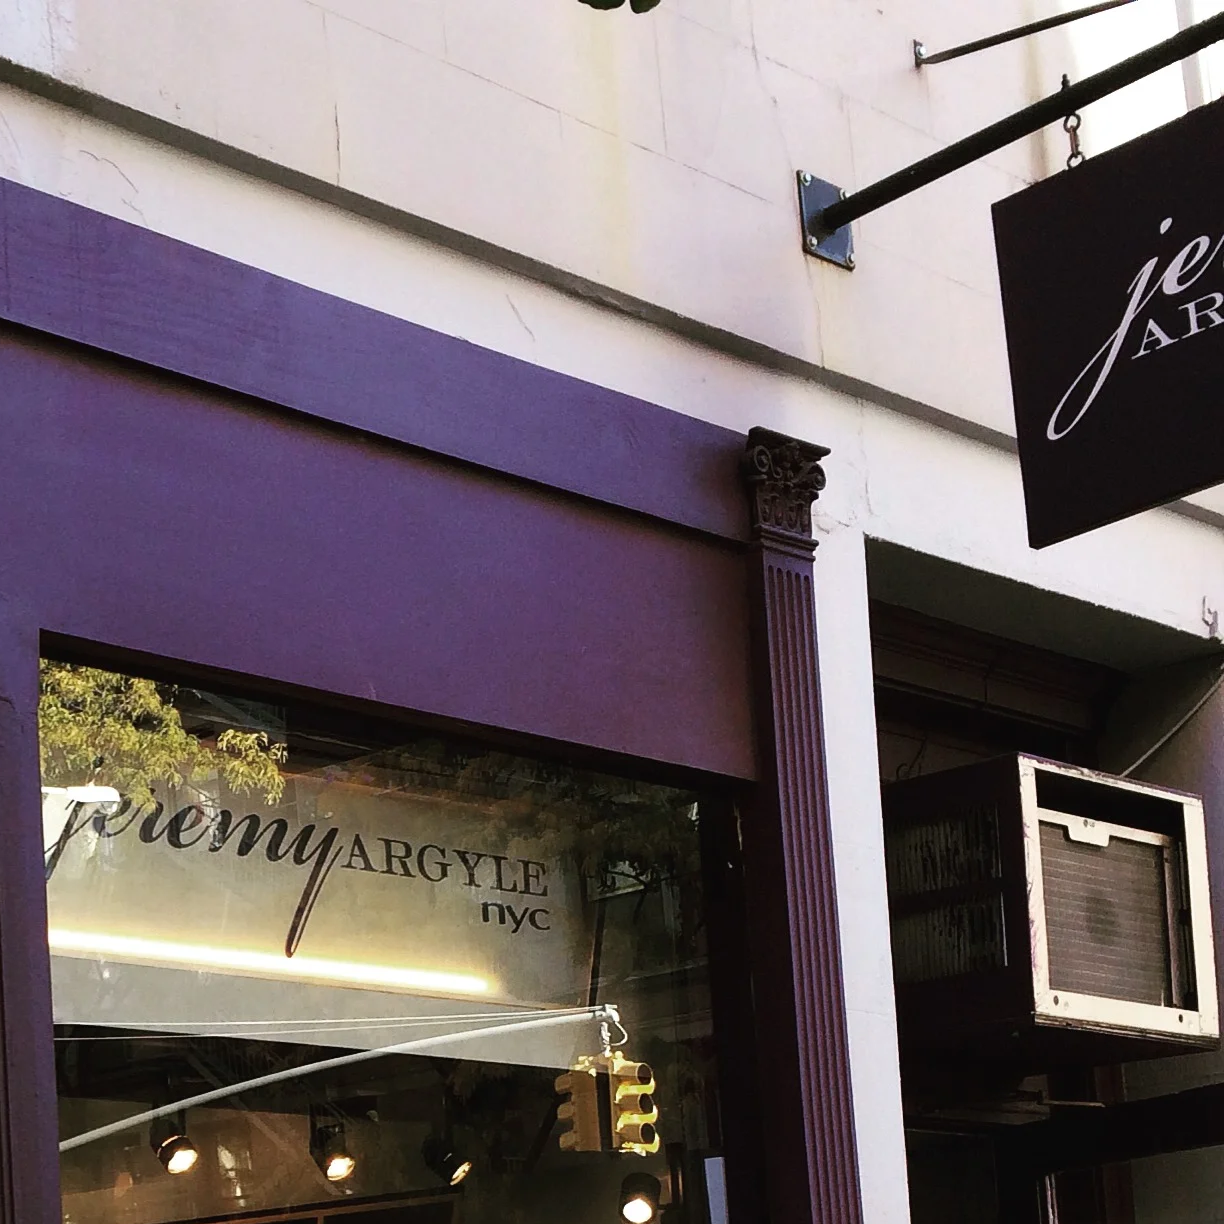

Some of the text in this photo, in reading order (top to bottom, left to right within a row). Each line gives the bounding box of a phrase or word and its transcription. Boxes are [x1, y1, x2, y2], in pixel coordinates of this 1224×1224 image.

[1046, 217, 1224, 441] je
[1131, 291, 1224, 360] AR
[341, 833, 548, 896] ARGYLE
[482, 901, 551, 933] nyc
